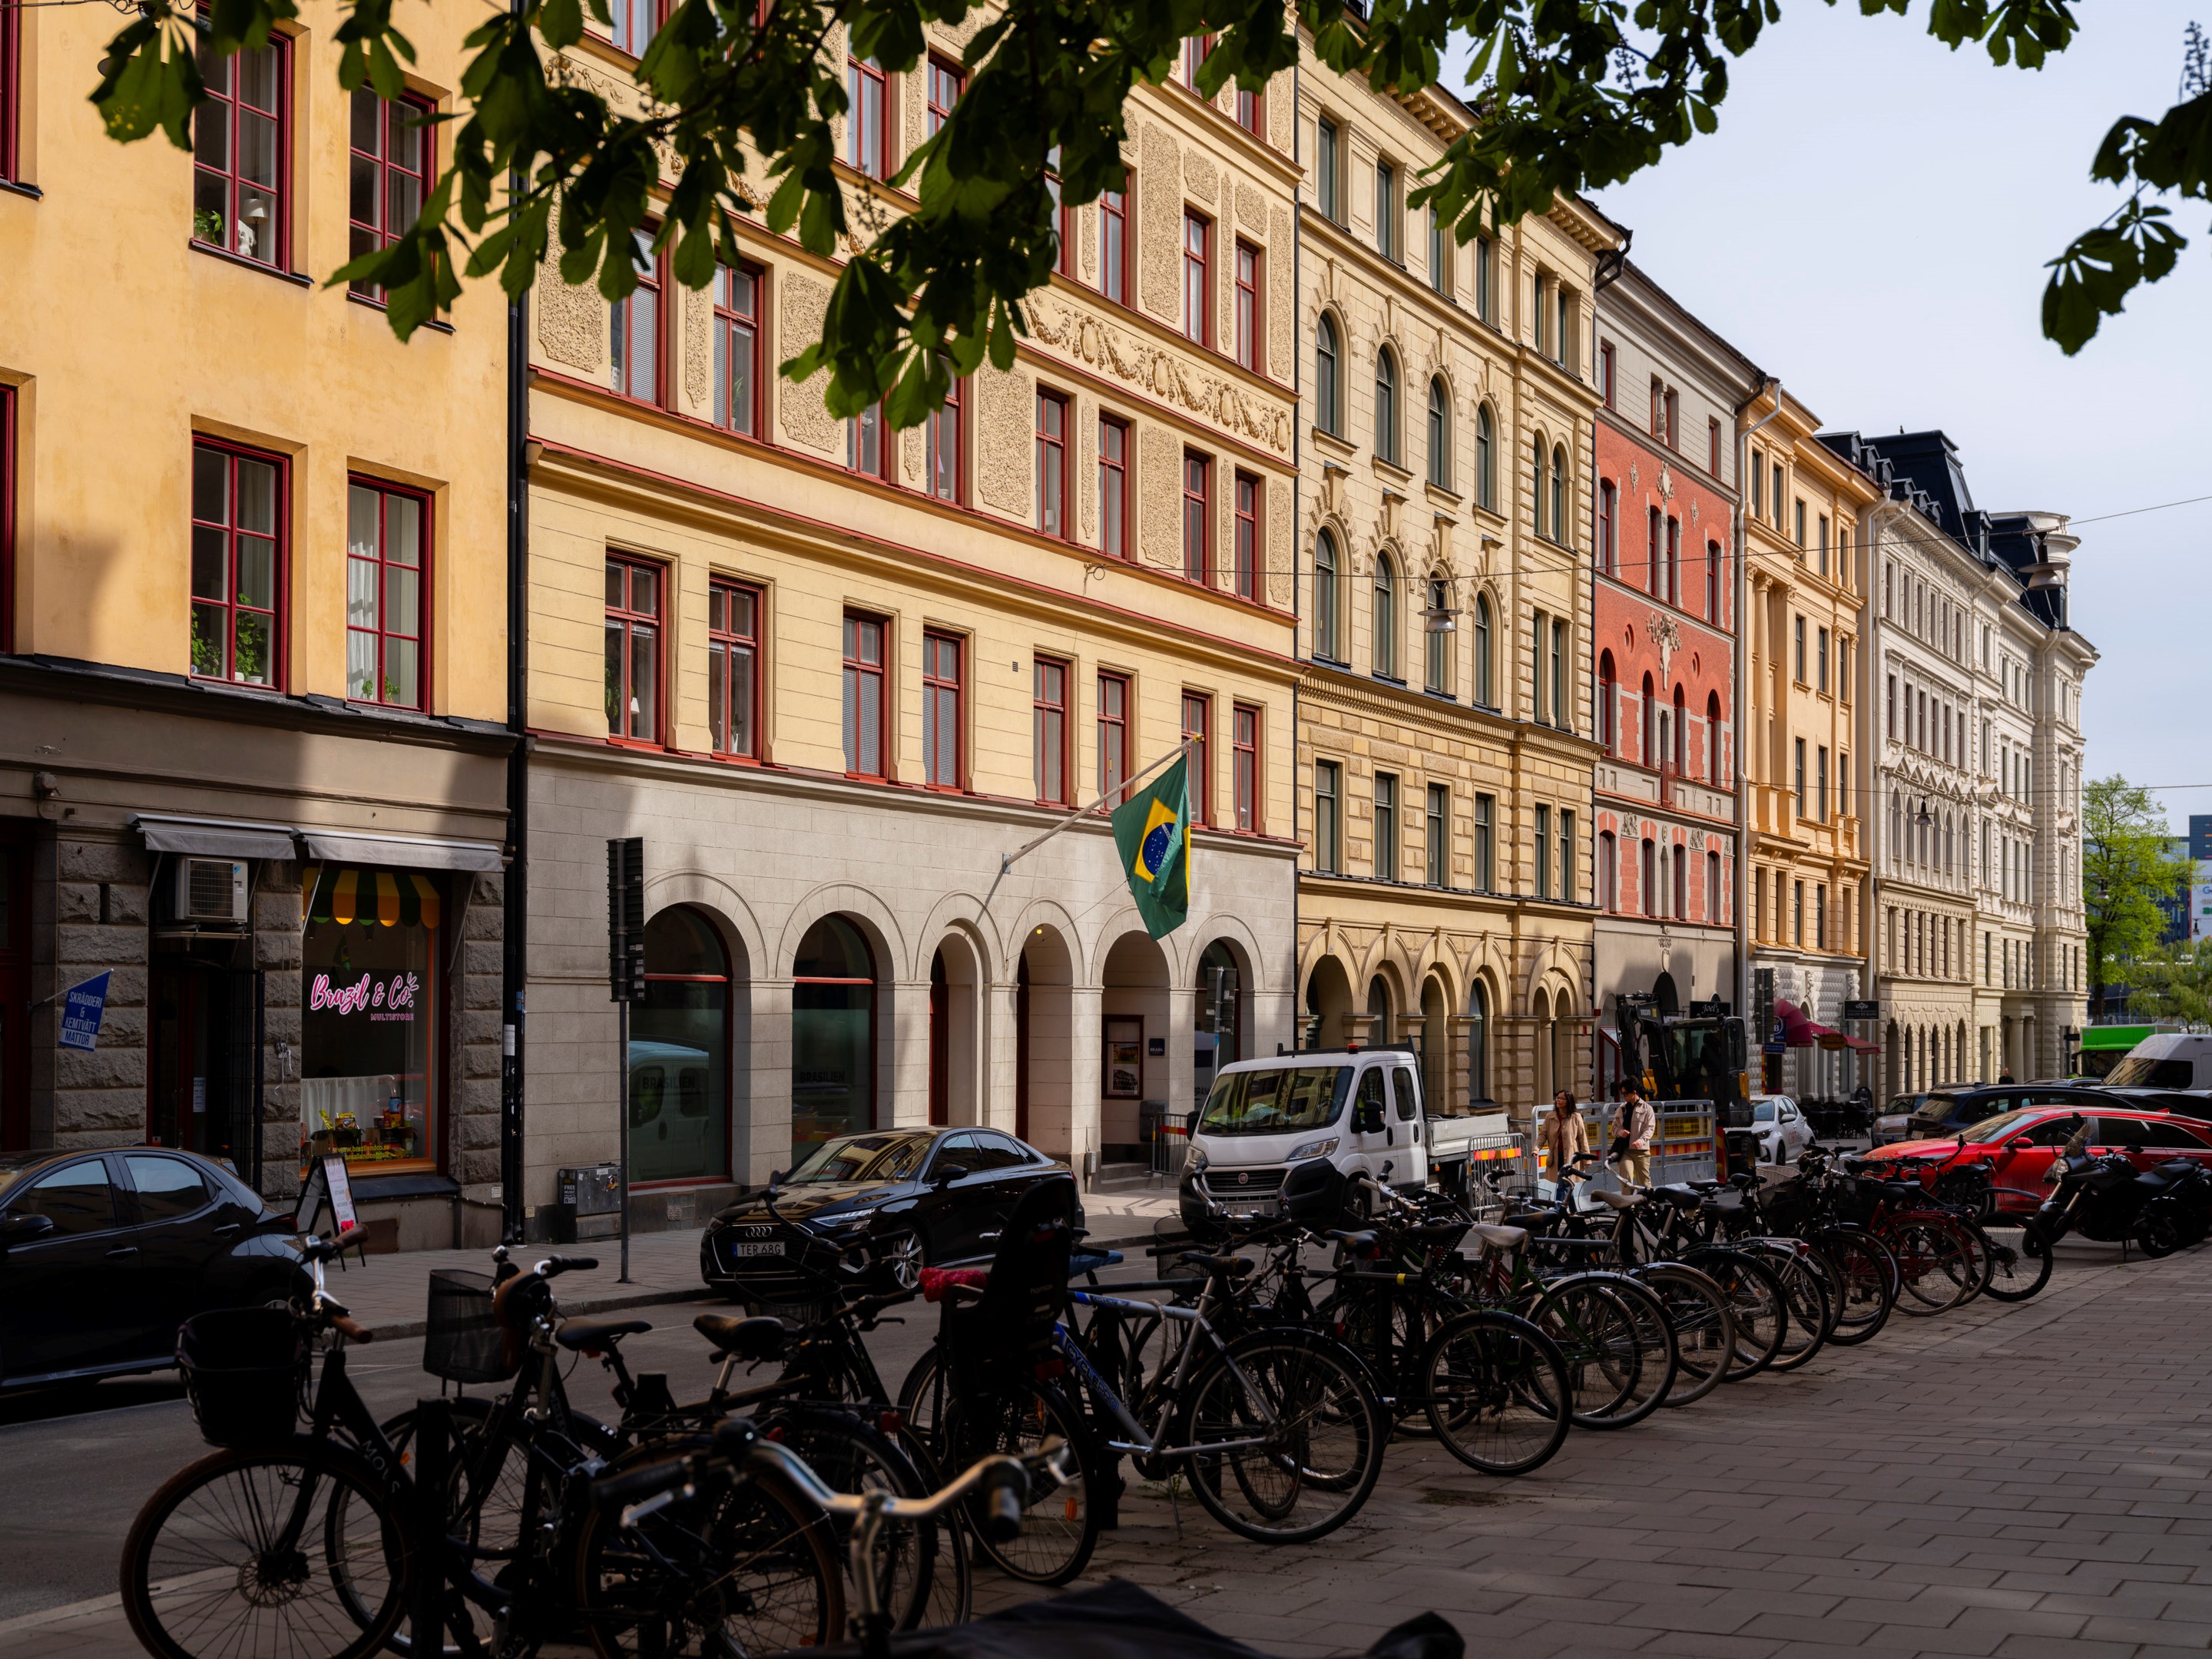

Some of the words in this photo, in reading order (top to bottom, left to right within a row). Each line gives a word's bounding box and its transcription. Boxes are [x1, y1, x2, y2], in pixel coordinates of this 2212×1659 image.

[69, 991, 103, 1008] SKRÄDDERI
[310, 972, 370, 1015] Brazil
[372, 982, 385, 1007] &
[79, 1007, 85, 1017] &
[1701, 1003, 1720, 1014] Joel's
[65, 1016, 97, 1033] KEMTVÄTT
[370, 1013, 414, 1022] MULTISTORE
[65, 1030, 90, 1045] MATTOR
[642, 1075, 695, 1089] BRASILIEN
[800, 1071, 845, 1083] BRASILIEN
[740, 1244, 758, 1256] TER
[762, 1243, 781, 1254] 68G
[1065, 1340, 1119, 1413] CYCLEPRO
